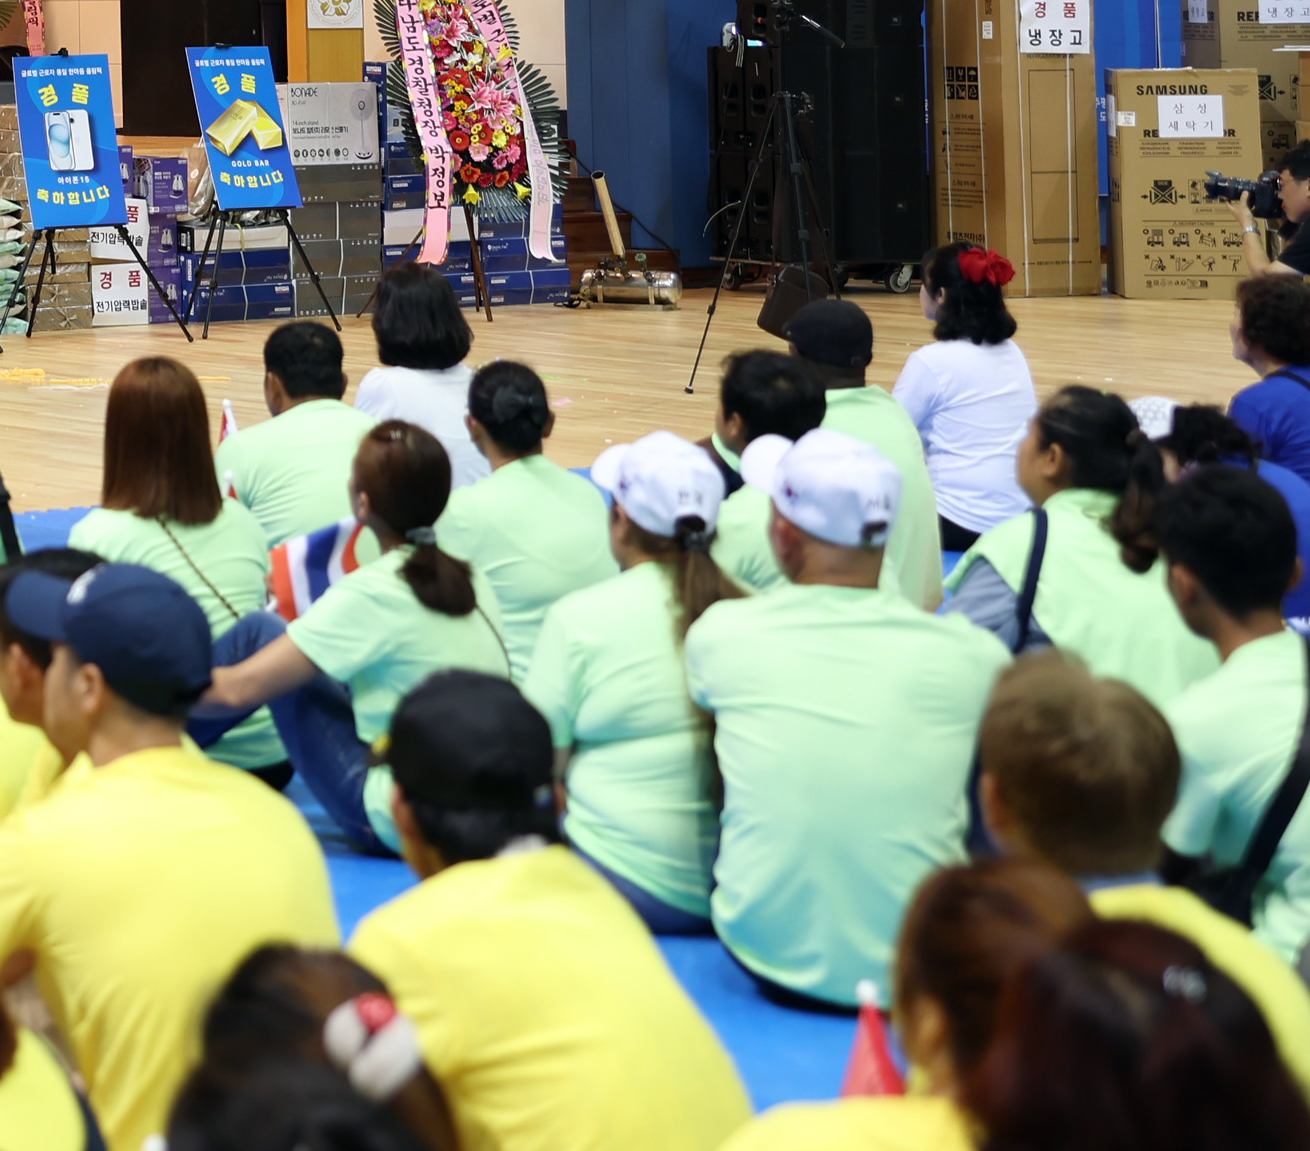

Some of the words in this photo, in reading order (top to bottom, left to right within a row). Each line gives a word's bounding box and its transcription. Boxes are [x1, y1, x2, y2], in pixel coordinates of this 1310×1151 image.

[291, 87, 318, 97] BONADE
[1136, 85, 1208, 95] SAMSUNG
[58, 177, 78, 185] 아이폰
[220, 170, 283, 188] 축하합니다
[428, 145, 449, 210] 박정보
[37, 185, 110, 205] 축하합니다
[96, 299, 147, 313] 전기압력밥솥
